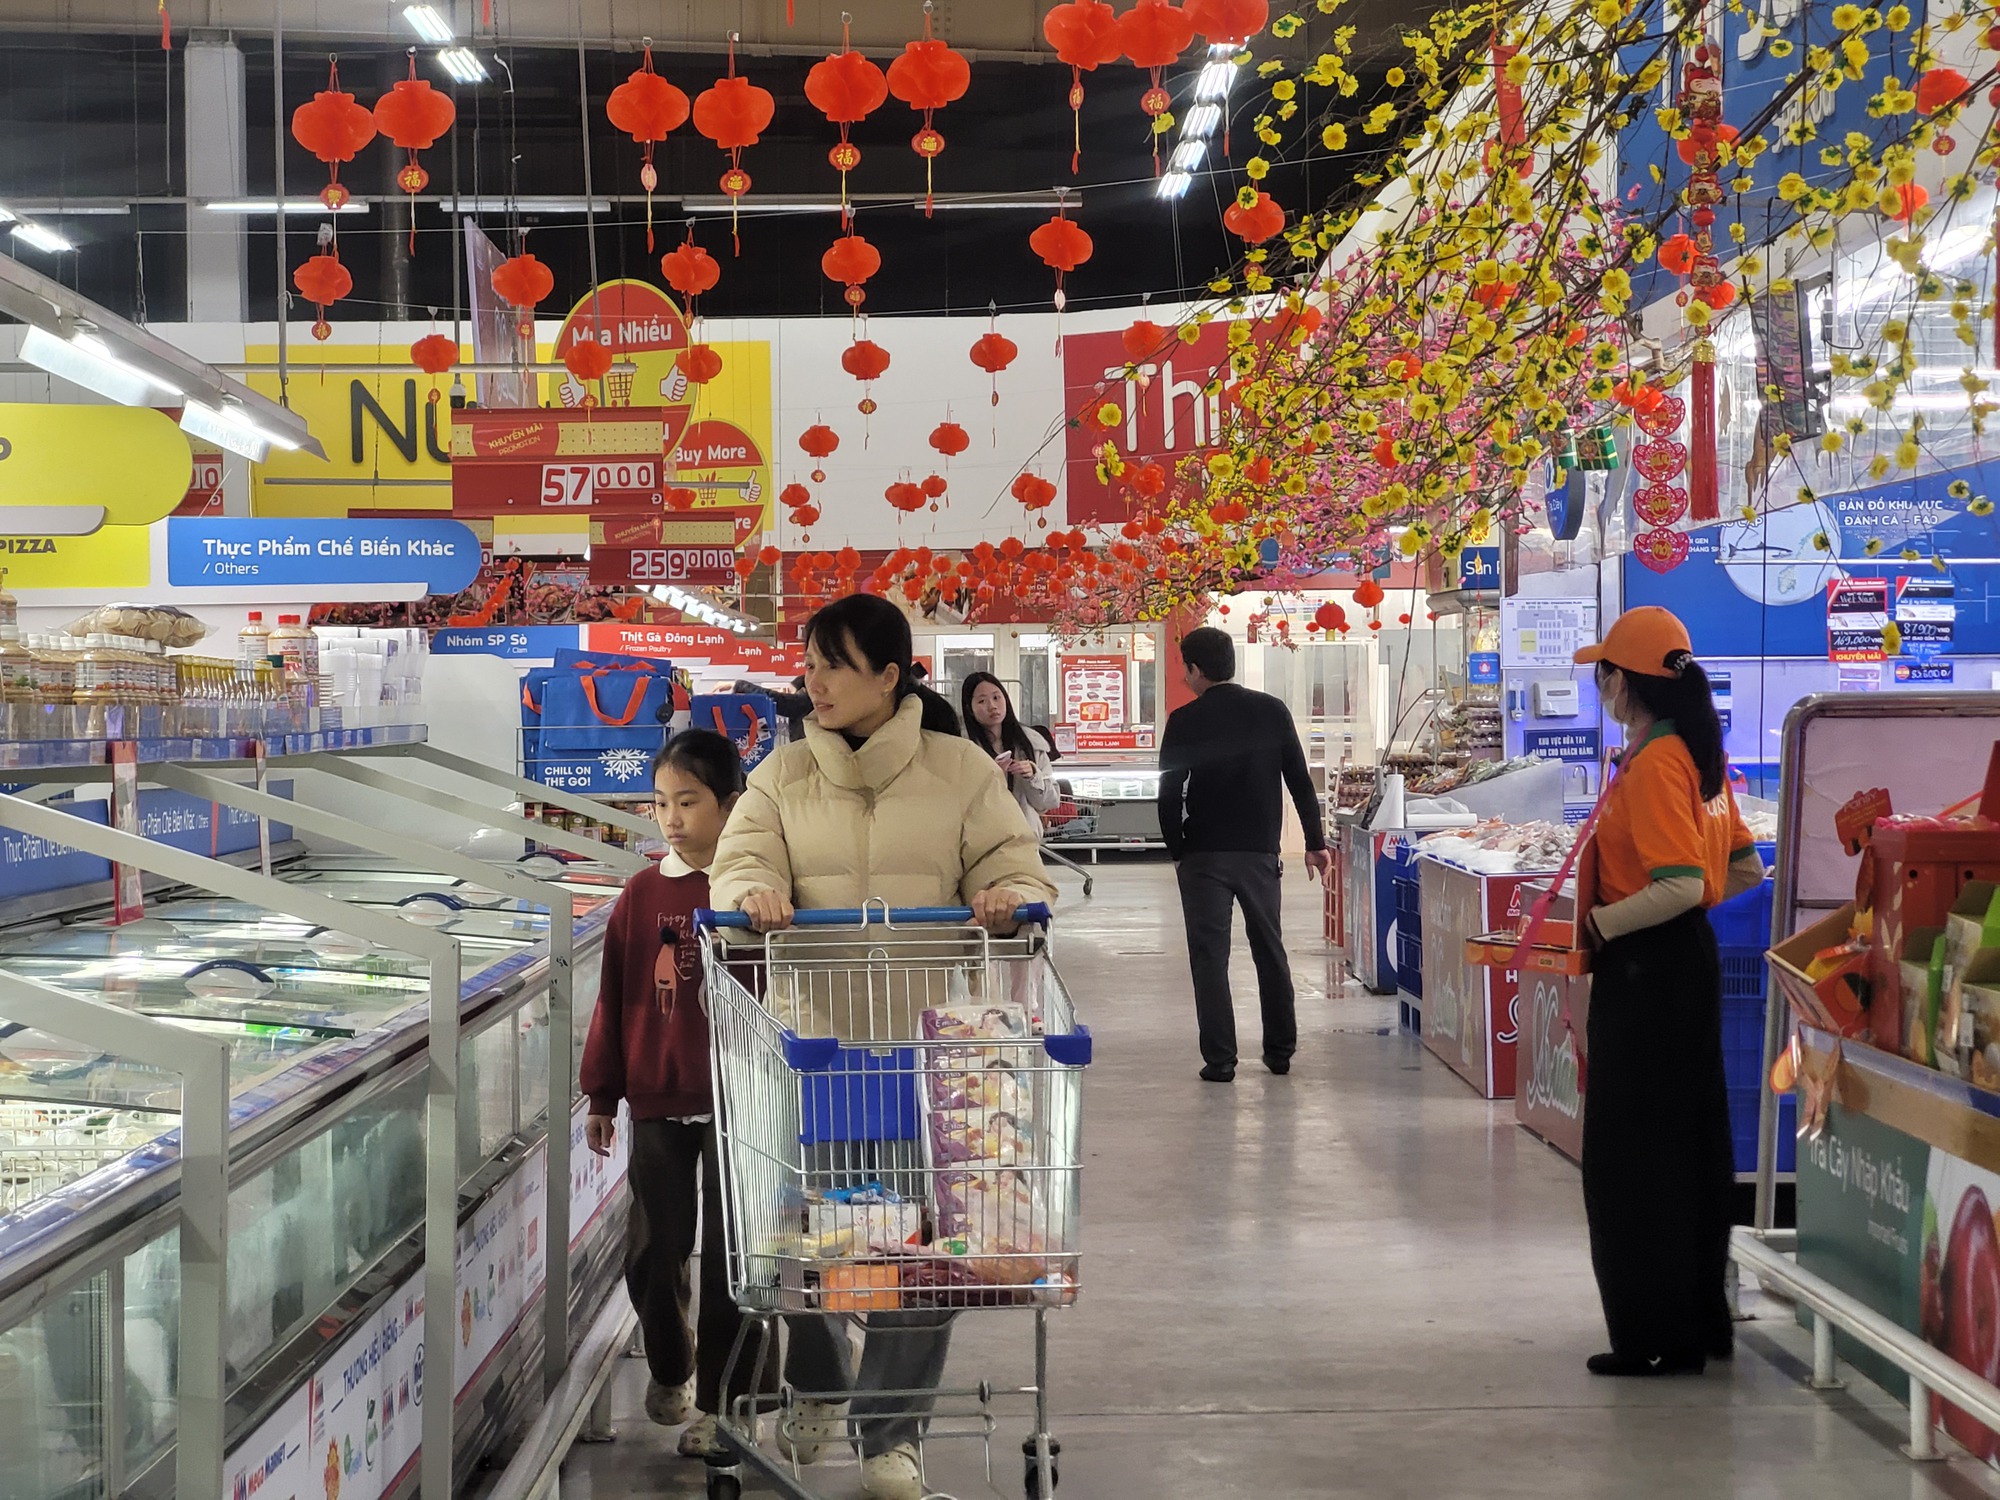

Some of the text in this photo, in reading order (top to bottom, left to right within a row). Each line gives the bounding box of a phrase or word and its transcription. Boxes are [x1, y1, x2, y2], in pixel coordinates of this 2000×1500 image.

[1147, 93, 1163, 110] 福
[836, 148, 854, 166] 福
[404, 171, 421, 188] 福
[618, 313, 672, 344] Nhiều
[498, 435, 541, 456] PROMOTION
[708, 444, 746, 461] More
[1888, 499, 1913, 510] KHU
[1917, 499, 1943, 512] VỰC
[1914, 515, 1938, 525] FAO
[203, 535, 455, 560] Thực Phẩm Chế Biến Khác
[214, 562, 259, 575] Others
[446, 632, 528, 647] Nhóm SP Sò
[620, 630, 725, 647] Thịt Gà Đông Lạnh
[738, 646, 762, 657] Lạnh
[1576, 736, 1587, 744] TAY
[544, 766, 591, 775] CHILL ON
[544, 777, 591, 786] THE GO!
